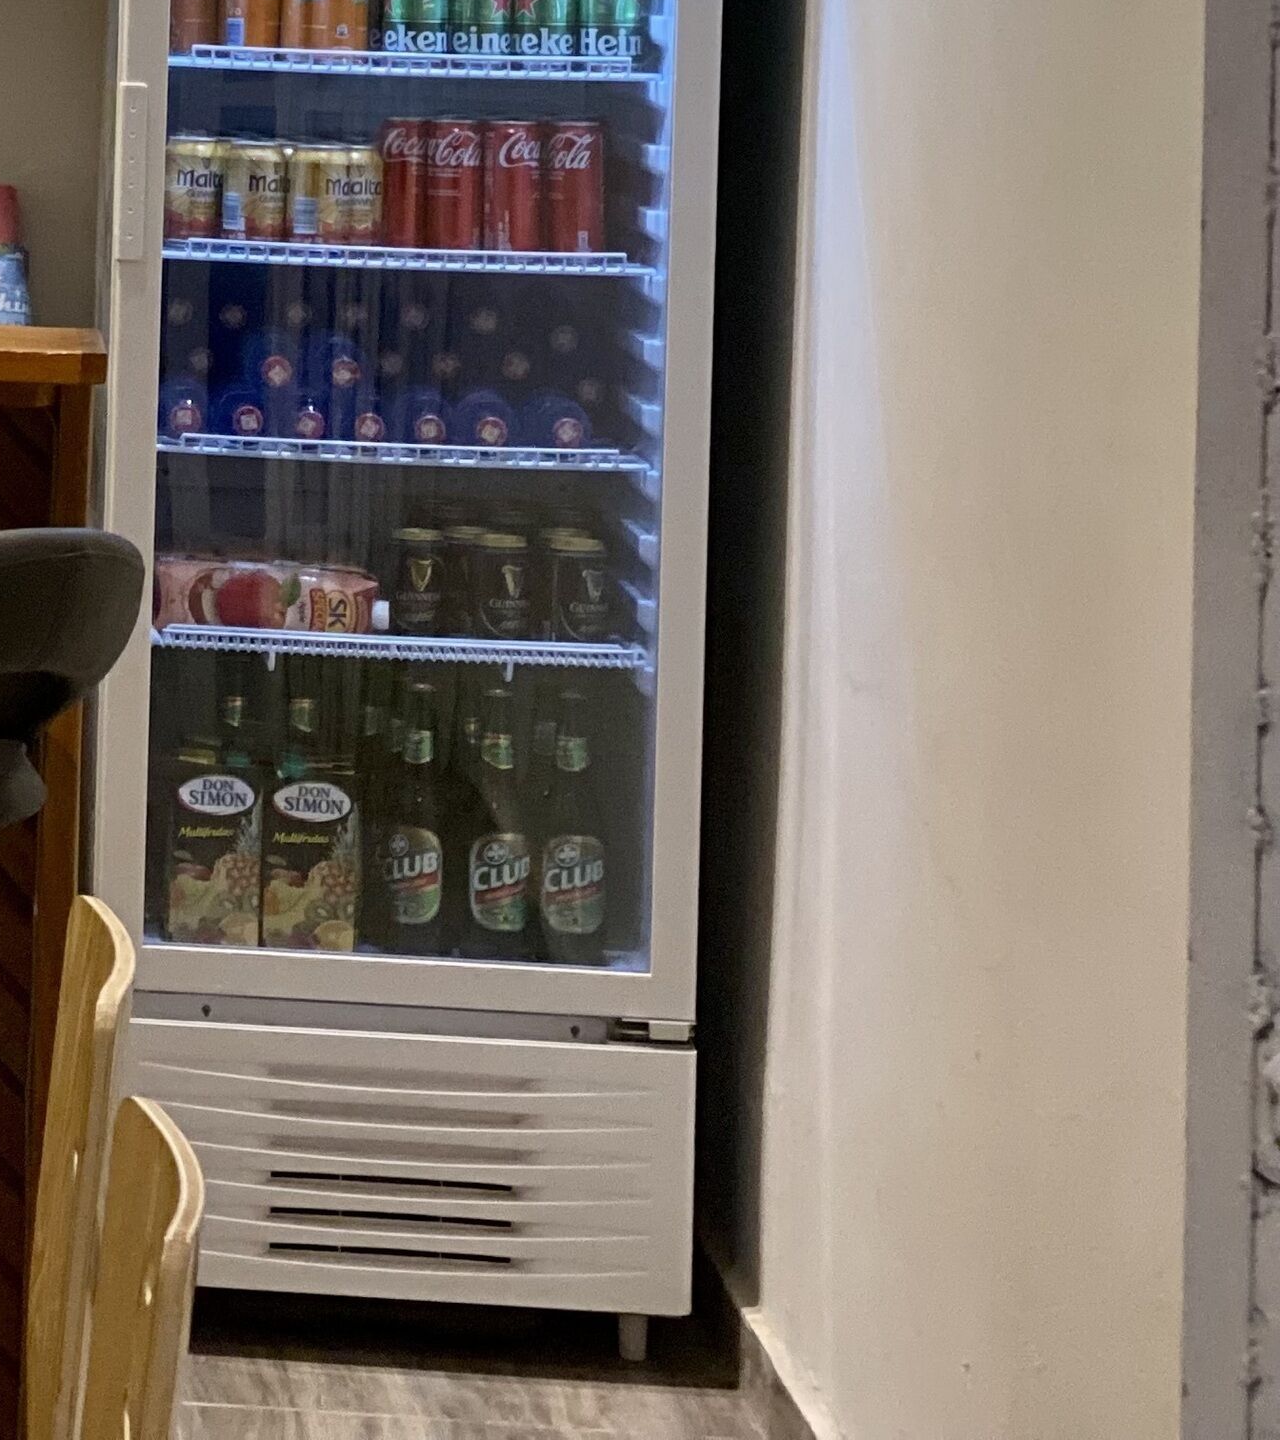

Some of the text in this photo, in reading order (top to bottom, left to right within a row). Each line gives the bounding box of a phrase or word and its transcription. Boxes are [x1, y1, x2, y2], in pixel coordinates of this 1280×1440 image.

[202, 778, 235, 792] DON
[297, 785, 333, 798] DON
[189, 790, 248, 808] SIMON
[283, 796, 345, 815] SIMON
[390, 851, 438, 880] LUB
[545, 859, 604, 893] CLUB
